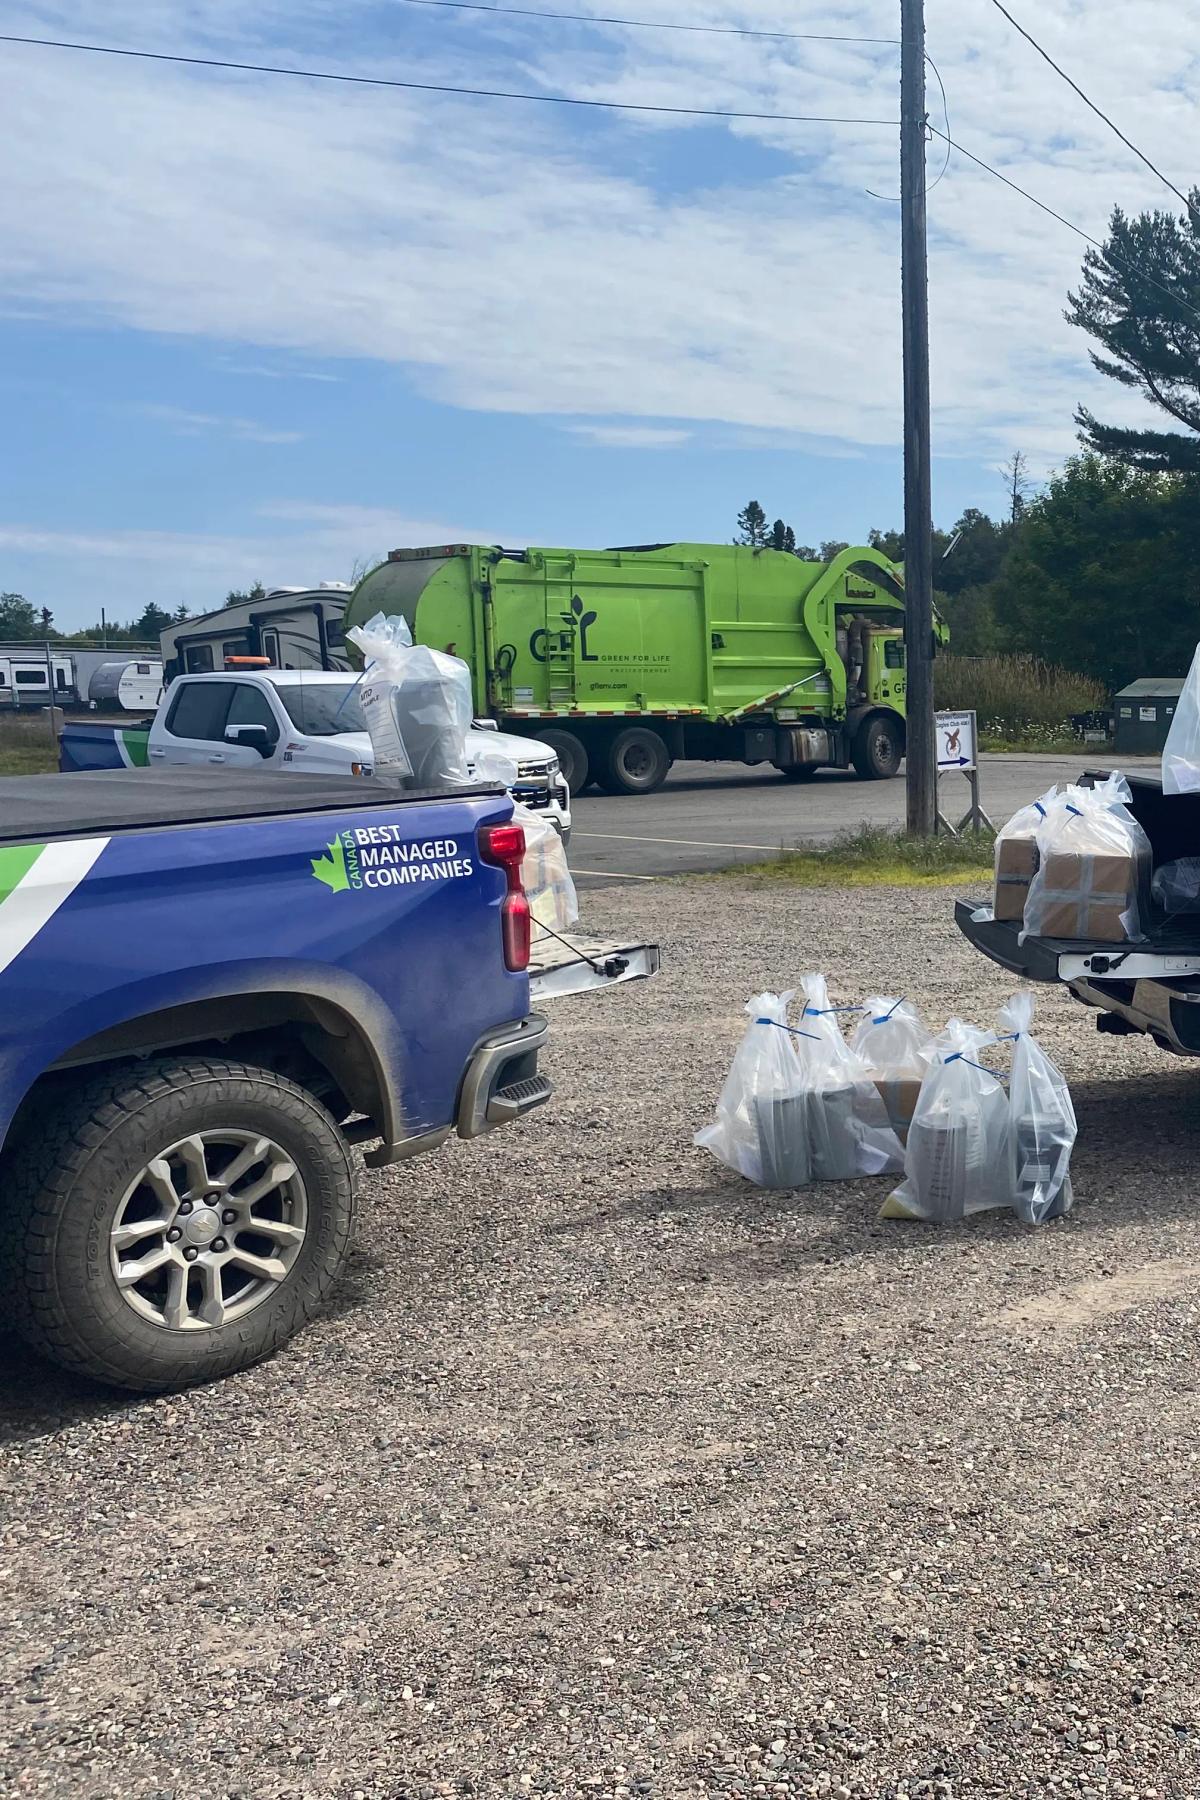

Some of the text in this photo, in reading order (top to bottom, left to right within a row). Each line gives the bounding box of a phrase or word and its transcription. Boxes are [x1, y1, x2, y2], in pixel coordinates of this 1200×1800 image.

[894, 682, 907, 694] GF
[355, 824, 401, 845] BEST
[341, 830, 362, 890] CANADA
[360, 840, 458, 867] MANAGED
[364, 858, 473, 888] COMPANIES
